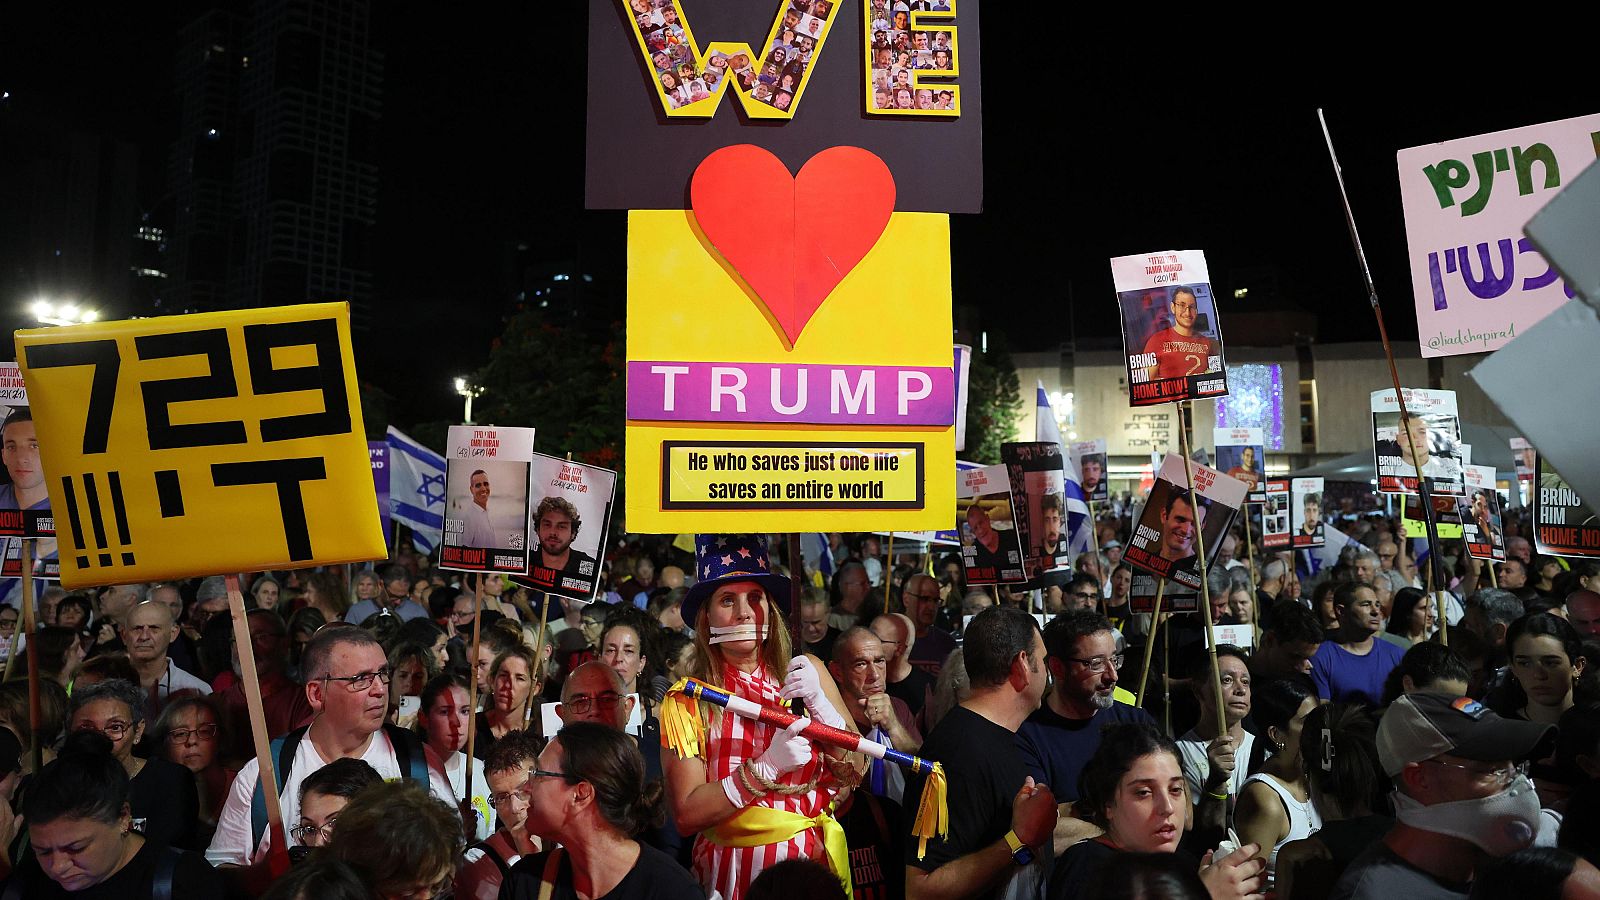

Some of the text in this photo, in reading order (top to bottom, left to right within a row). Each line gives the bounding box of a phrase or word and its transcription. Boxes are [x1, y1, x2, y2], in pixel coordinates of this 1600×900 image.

[621, 0, 961, 119] WE
[1428, 238, 1577, 311] כשיו
[1428, 323, 1516, 349] @liadshapira1
[1129, 352, 1158, 369] BRING
[1131, 368, 1150, 384] HIM
[24, 318, 352, 454] 729
[651, 365, 933, 416] TRUMP
[1133, 377, 1188, 399] HOME NOW!
[688, 452, 899, 473] He who saves just one life
[1378, 455, 1402, 466] BRING
[1379, 466, 1395, 476] HIM
[708, 480, 884, 500] saves an entire world
[1540, 506, 1566, 525] HIM
[445, 518, 464, 533] BRING
[1137, 524, 1160, 542] BRING
[444, 532, 458, 546] HIM
[1132, 535, 1149, 550] HIM
[1541, 527, 1578, 546] HOME
[443, 546, 486, 564] HOME NOW!
[1127, 546, 1172, 573] HOME NOW!
[534, 567, 556, 583] NOW!
